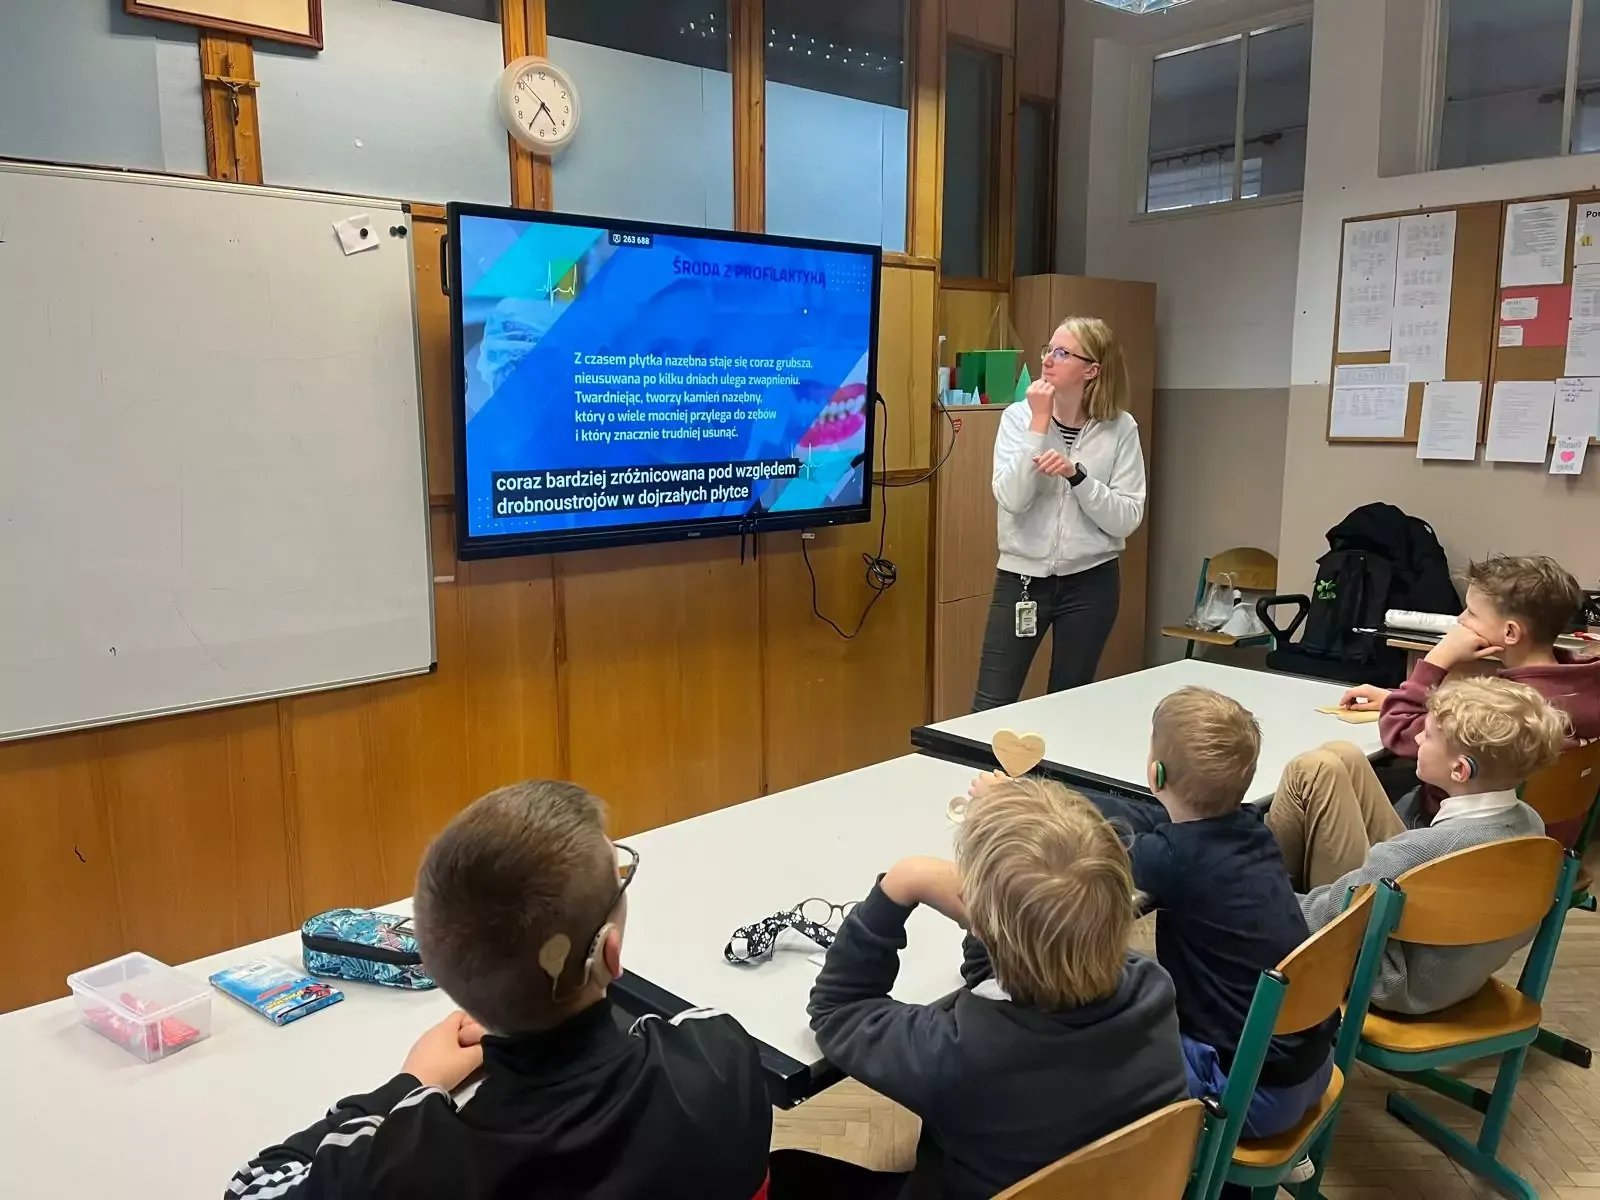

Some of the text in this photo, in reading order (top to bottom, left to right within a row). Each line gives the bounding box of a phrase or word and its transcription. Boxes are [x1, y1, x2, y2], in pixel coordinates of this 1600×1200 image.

[526, 74, 533, 82] 11
[538, 72, 546, 80] 12
[517, 82, 525, 91] 10
[561, 91, 566, 99] 2
[518, 111, 523, 119] 8
[561, 119, 566, 127] 4
[539, 129, 545, 137] 6
[552, 127, 557, 135] 5
[672, 255, 826, 289] ŚRODA Z PROFILAKTYKĄ
[574, 352, 582, 365] Z
[584, 355, 627, 365] czasem
[665, 354, 707, 369] nazębna
[709, 356, 732, 370] staje
[734, 356, 748, 369] się
[749, 358, 775, 368] coraz
[574, 372, 801, 388] nieusuwana po kilku dniach ulega zwapnieniu.
[574, 391, 763, 406] Twardniejąc, tworzy kamień nazębny,
[575, 408, 777, 425] który o wiele mocniej przylega do zębów
[581, 429, 612, 444] który
[613, 427, 660, 441] znacznie
[661, 427, 701, 441] trudniej
[702, 425, 739, 440] usunąć.
[496, 461, 796, 491] coraz bardziej zróżnicowana pod względem
[496, 484, 749, 515] drobnoustrojów w dojrzałych płytce
